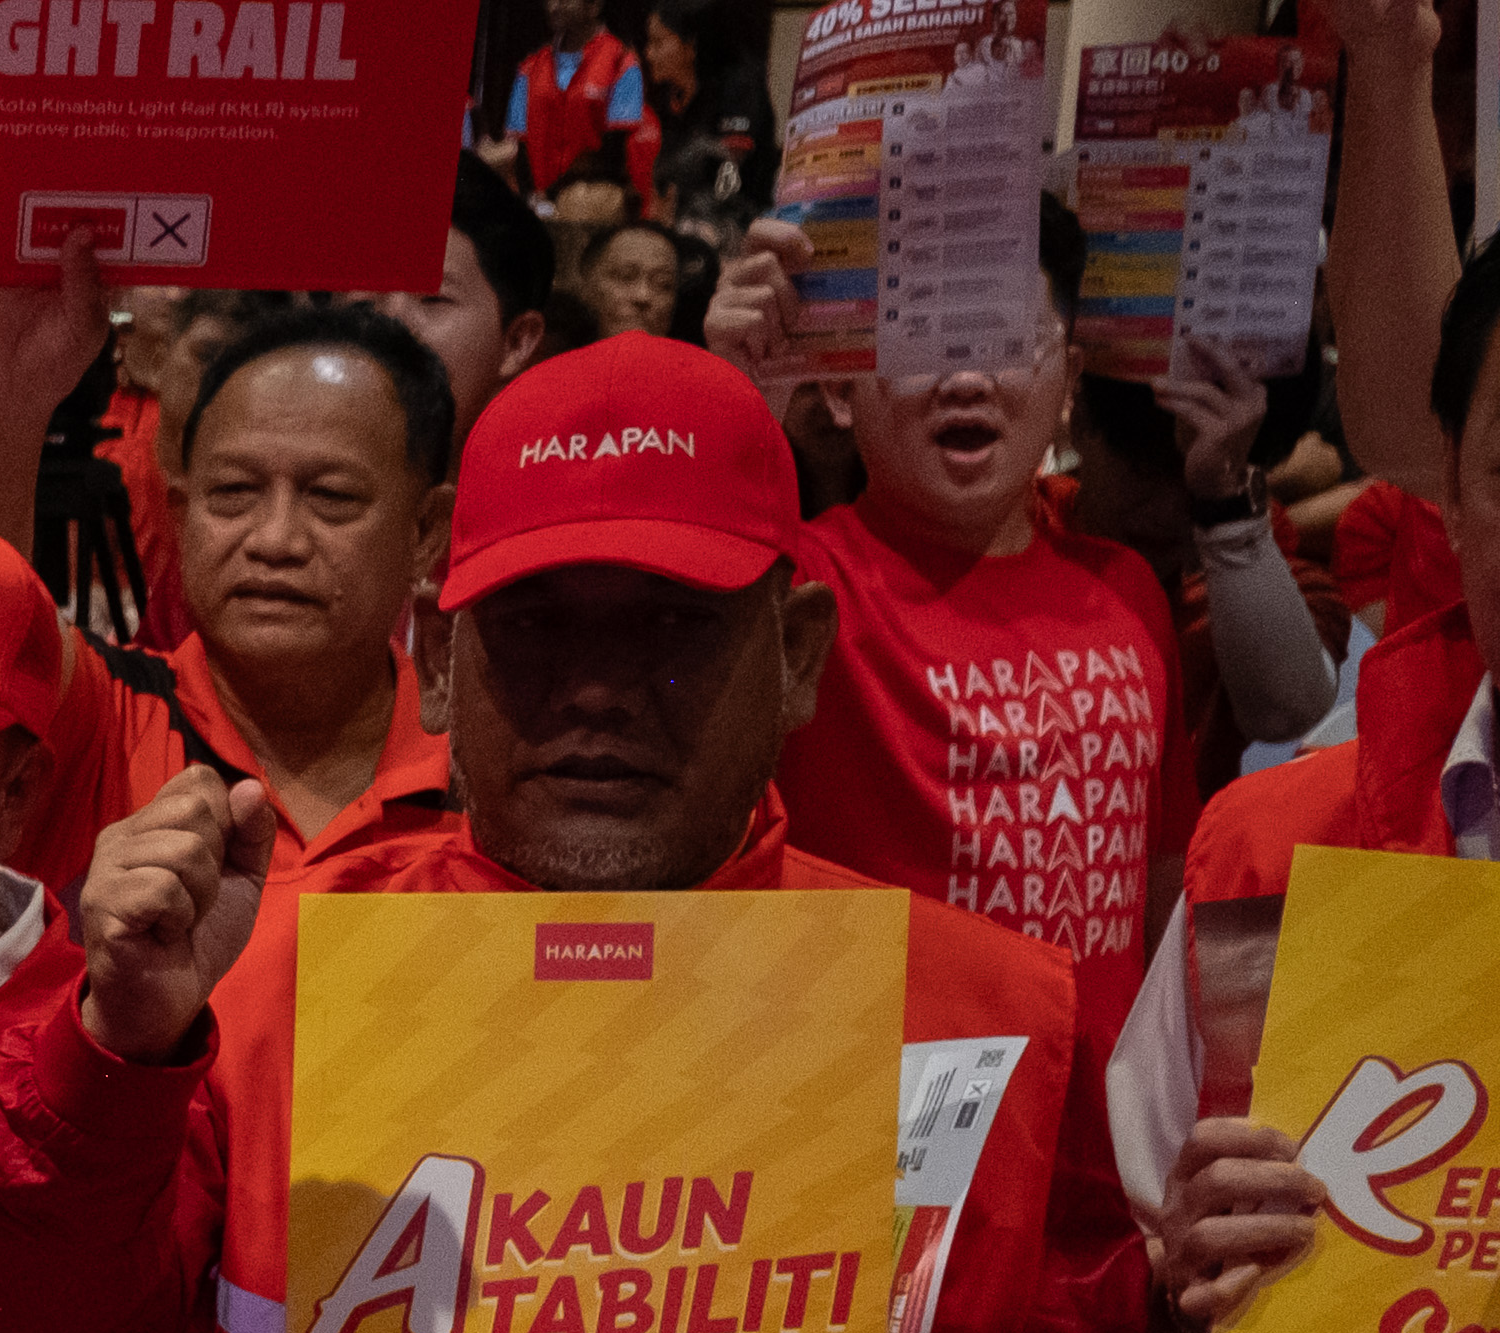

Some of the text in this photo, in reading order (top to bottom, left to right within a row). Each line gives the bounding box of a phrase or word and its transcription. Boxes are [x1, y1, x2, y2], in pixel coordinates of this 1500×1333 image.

[166, 1, 357, 81] RAIL
[42, 98, 123, 116] Kinabalu
[128, 100, 175, 118] Light
[519, 424, 696, 470] HARAPAN
[927, 644, 1143, 700] HARAPAN
[948, 728, 1158, 782] HARAPAN
[545, 941, 644, 961] HARAPAN
